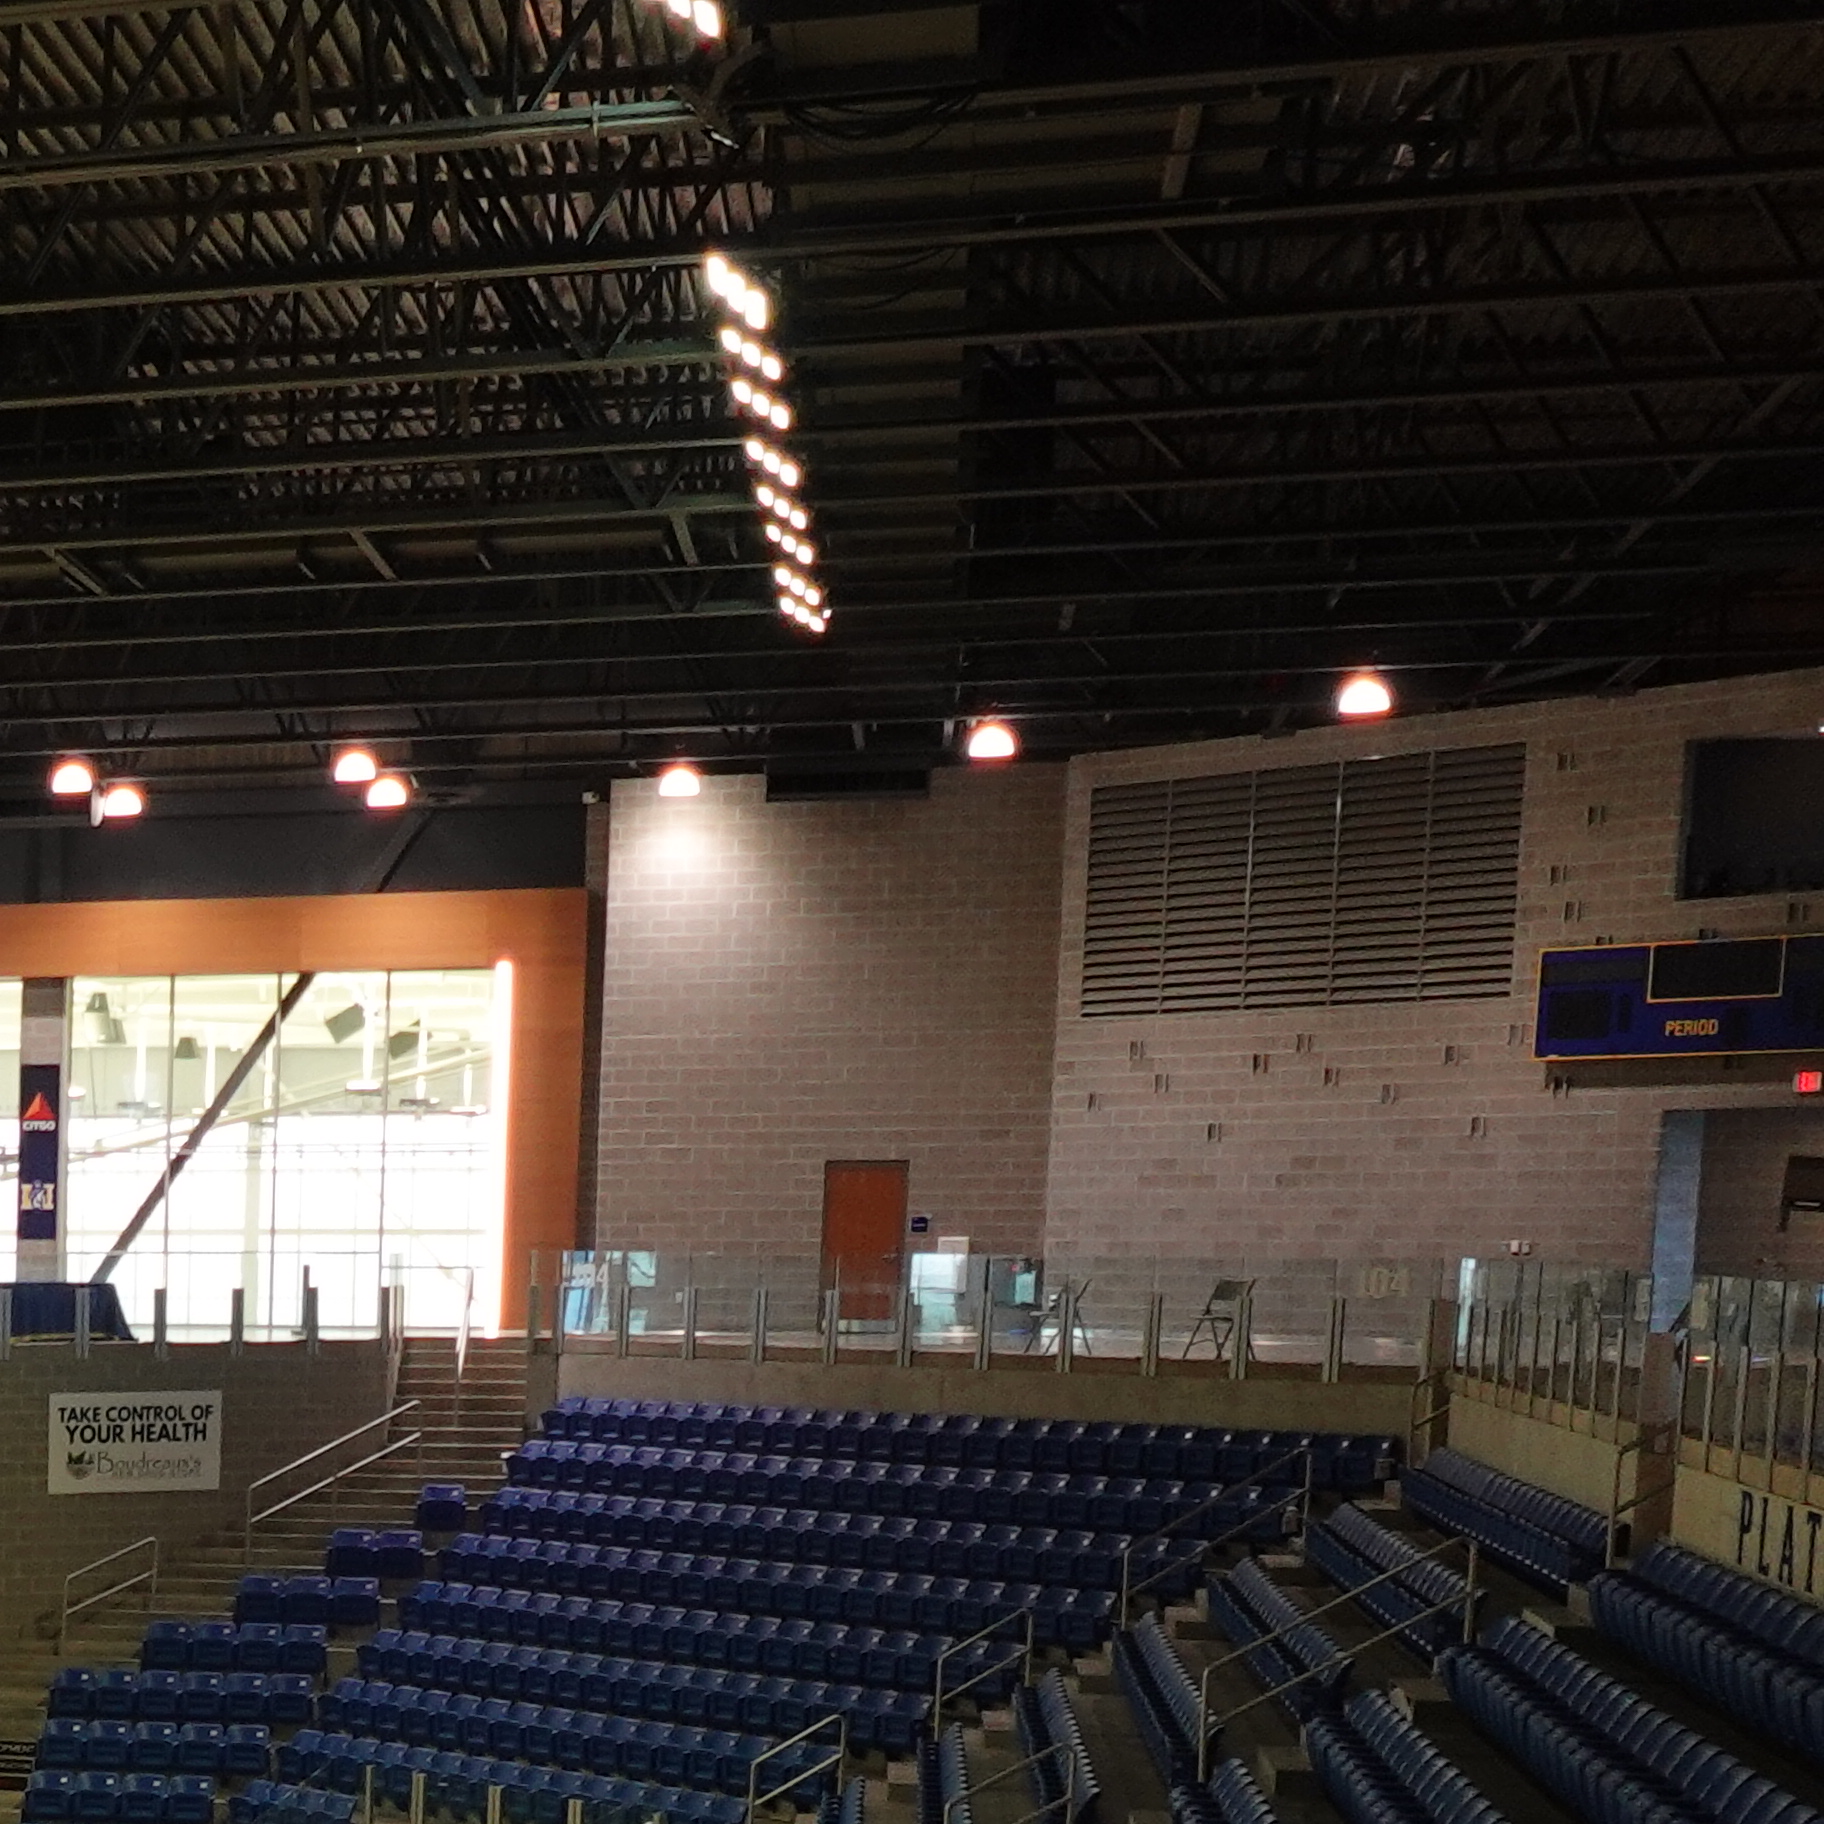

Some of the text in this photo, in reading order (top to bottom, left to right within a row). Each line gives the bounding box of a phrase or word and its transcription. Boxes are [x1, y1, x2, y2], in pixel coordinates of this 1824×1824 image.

[1664, 1018, 1720, 1037] PERIOD
[58, 1404, 215, 1424] TAKE CONTROL OF
[65, 1422, 208, 1446] YOUR HEALTH
